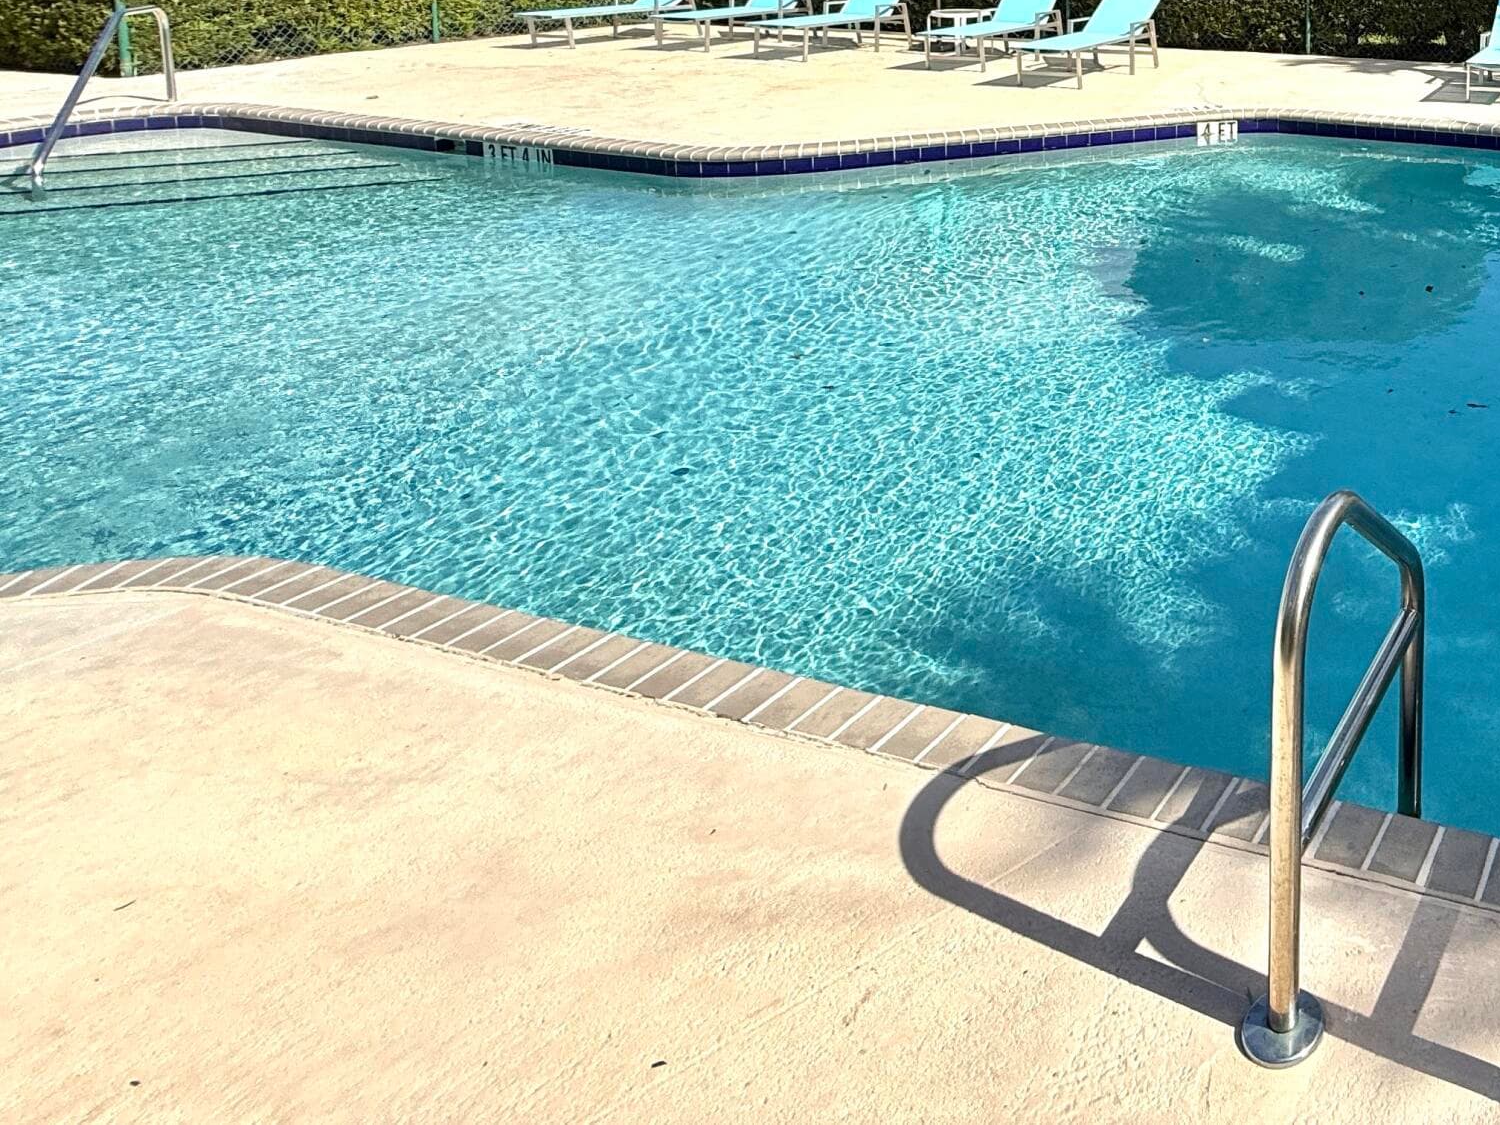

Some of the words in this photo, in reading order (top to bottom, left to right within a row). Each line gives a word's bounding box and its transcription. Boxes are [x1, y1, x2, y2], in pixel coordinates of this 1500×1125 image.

[1201, 122, 1215, 136] 4
[488, 144, 496, 158] 3
[500, 145, 517, 161] FT
[522, 147, 530, 162] 4
[536, 148, 551, 164] IN
